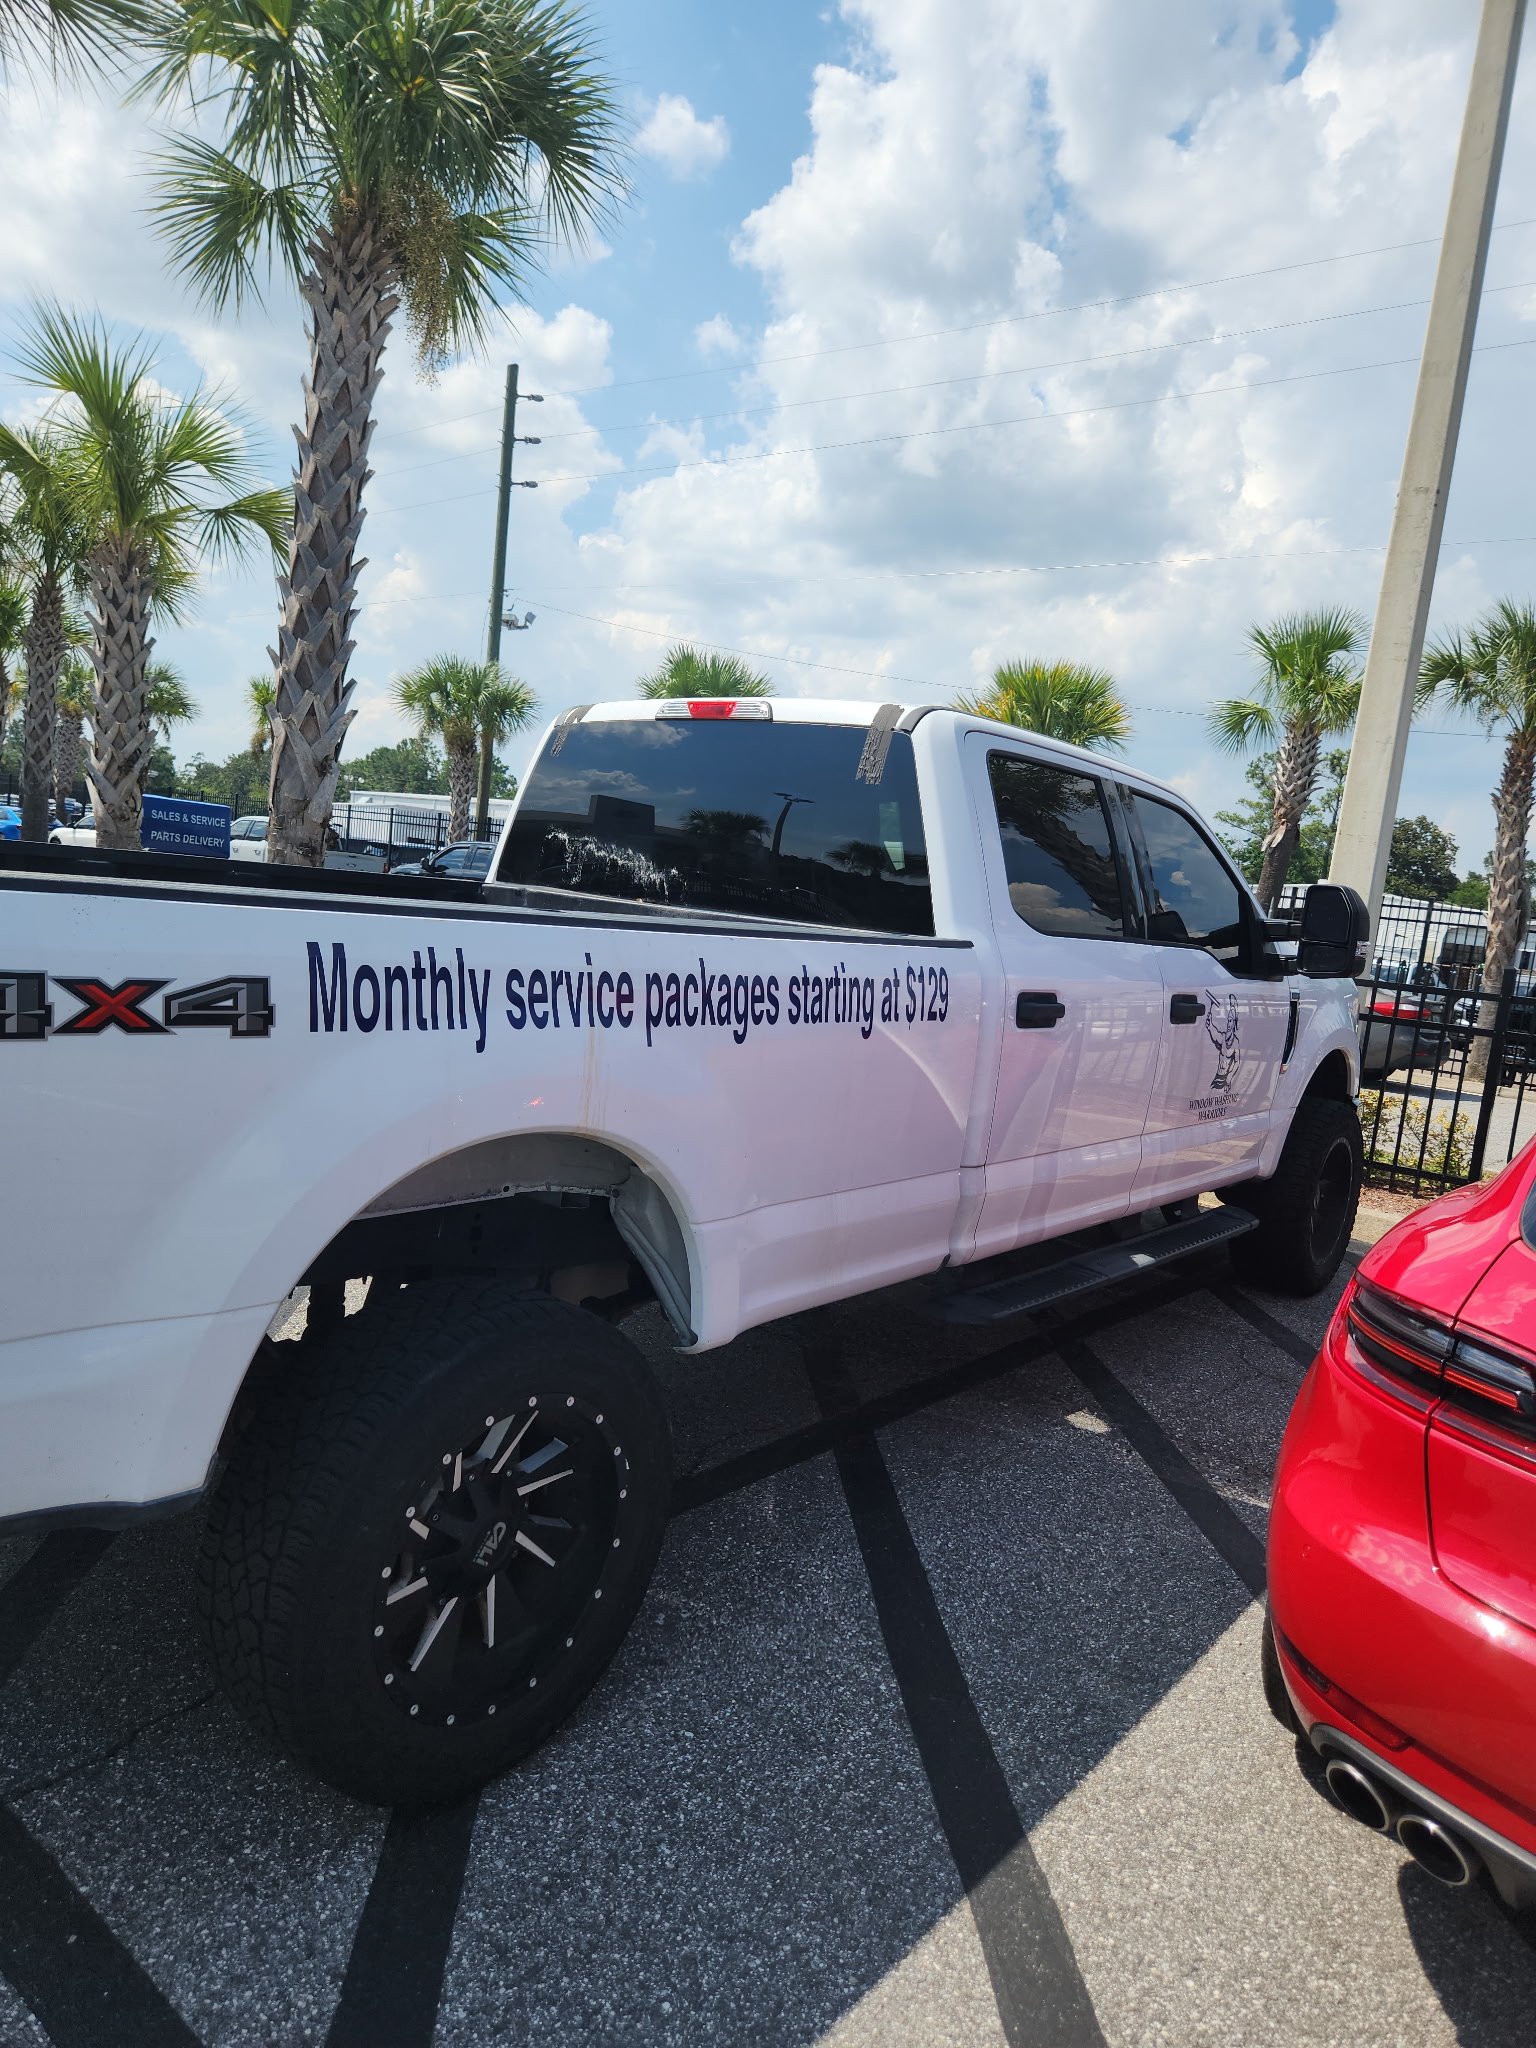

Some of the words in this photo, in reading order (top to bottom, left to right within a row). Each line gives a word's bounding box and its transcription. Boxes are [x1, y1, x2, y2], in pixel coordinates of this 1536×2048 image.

[151, 809, 180, 822] SALES
[182, 813, 189, 823] &
[190, 815, 226, 828] SERVICE
[150, 830, 181, 843] PARTS
[182, 834, 225, 848] DELIVERY
[306, 941, 491, 1054] Monthly
[505, 952, 635, 1030] service
[645, 957, 780, 1047] packages
[787, 961, 874, 1040] starting
[881, 967, 900, 1023] at
[905, 960, 949, 1030] $129
[1189, 1097, 1214, 1110] WINDOW
